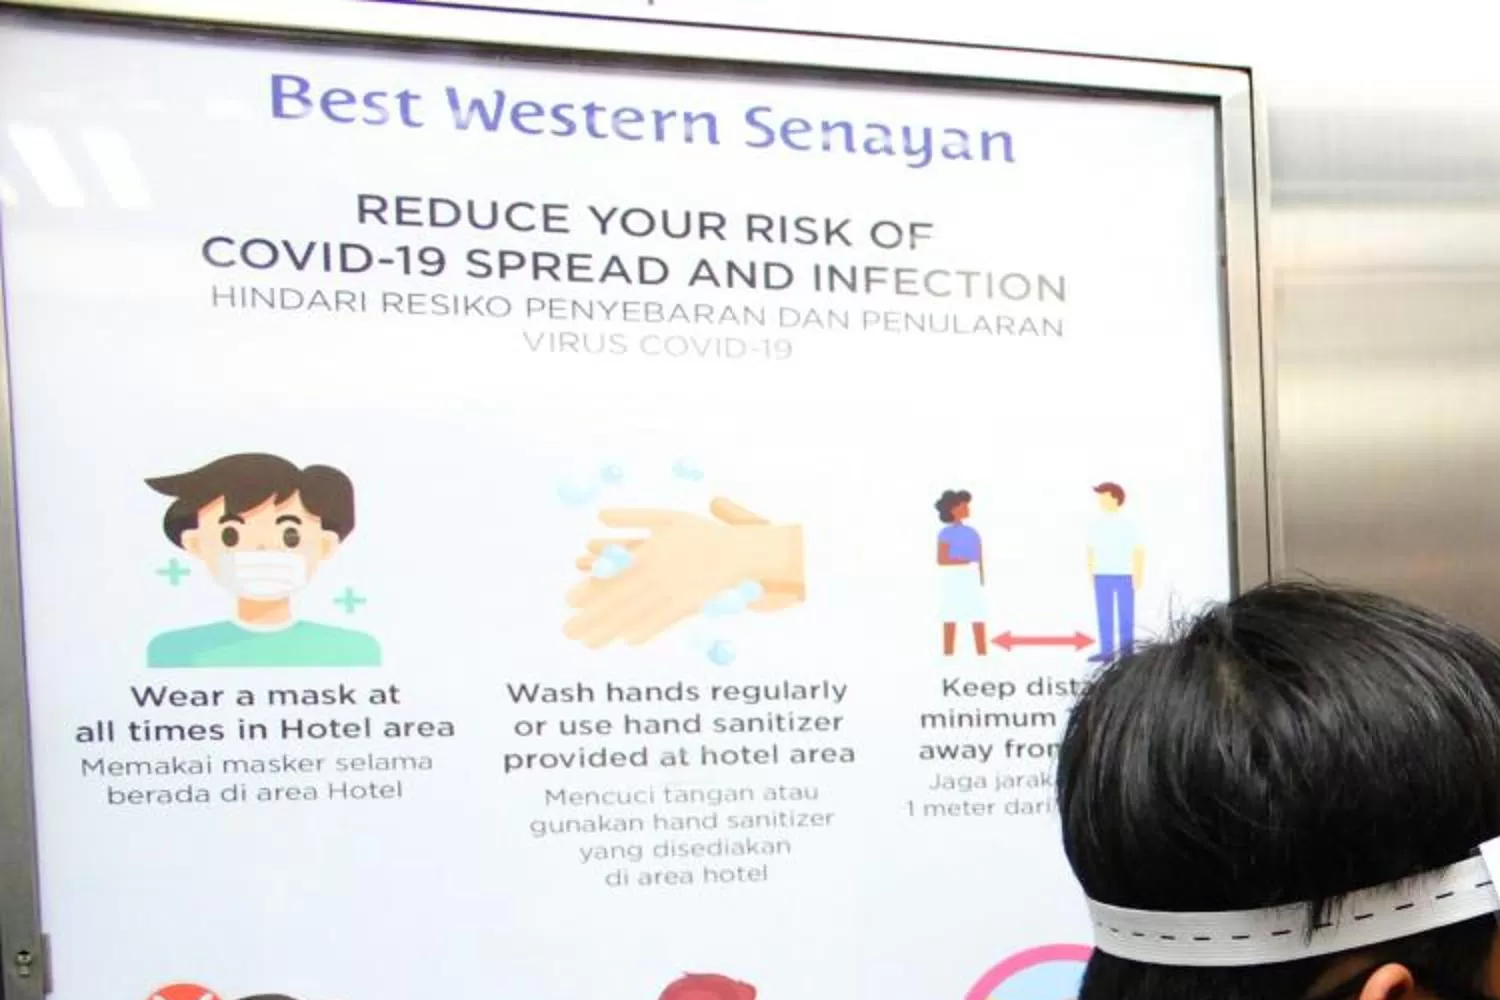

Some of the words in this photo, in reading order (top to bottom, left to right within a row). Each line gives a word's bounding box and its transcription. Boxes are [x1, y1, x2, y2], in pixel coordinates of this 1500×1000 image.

[270, 73, 424, 129] Best
[445, 86, 721, 145] Western
[744, 105, 1016, 169] Senayan
[357, 193, 570, 234] REDUCE
[587, 205, 727, 241] YOUR
[746, 213, 853, 247] RISK
[869, 220, 934, 251] OF
[201, 235, 447, 277] COVID-19
[466, 248, 670, 286] SPREAD
[687, 258, 794, 291] AND
[813, 262, 1066, 302] INFECTION
[211, 284, 367, 313] HINDARI
[381, 291, 513, 318] RESIKO
[525, 296, 766, 326] PENYEBARAN
[778, 306, 850, 331] DAN
[862, 309, 1064, 337] PENULARAN
[522, 330, 628, 355] VIRUS
[639, 333, 793, 361] COVID-19
[130, 685, 225, 708] Wear
[235, 689, 255, 707] a
[267, 683, 357, 706] mask
[368, 684, 401, 705] at
[506, 681, 595, 704] Wash
[606, 681, 700, 703] hands
[711, 679, 848, 705] regularly
[942, 677, 1017, 701] Keep
[75, 719, 115, 743] all
[127, 719, 225, 742] times
[238, 718, 268, 741] in
[281, 716, 371, 740] Hotel
[383, 721, 455, 738] area
[513, 719, 547, 737] or
[559, 719, 613, 737] use
[623, 713, 701, 735] hand
[712, 711, 844, 733] sanitizer
[920, 707, 1057, 729] minimum
[81, 754, 212, 777] Memakai
[222, 753, 325, 774] masker
[335, 752, 433, 773] selama
[503, 745, 649, 775] provided
[659, 747, 690, 768] at
[700, 743, 779, 766] hotel
[789, 747, 856, 765] area
[919, 743, 993, 764] away
[107, 783, 211, 806] berada
[220, 783, 247, 803] di
[256, 786, 318, 802] area
[328, 779, 403, 801] Hotel
[928, 773, 988, 793] Jaga
[995, 771, 1053, 791] jarak
[544, 785, 655, 807] Mencuci
[662, 785, 755, 807] tangan
[763, 784, 819, 801] atau
[907, 800, 915, 816] 1
[923, 799, 996, 817] meter
[1004, 799, 1051, 816] dari
[529, 813, 645, 839] gunakan
[652, 811, 718, 832] hand
[726, 810, 835, 829] sanitizer
[579, 844, 644, 865] yang
[652, 836, 792, 859] disediakan
[604, 868, 629, 888] di
[637, 870, 694, 887] area
[703, 863, 769, 884] hotel
